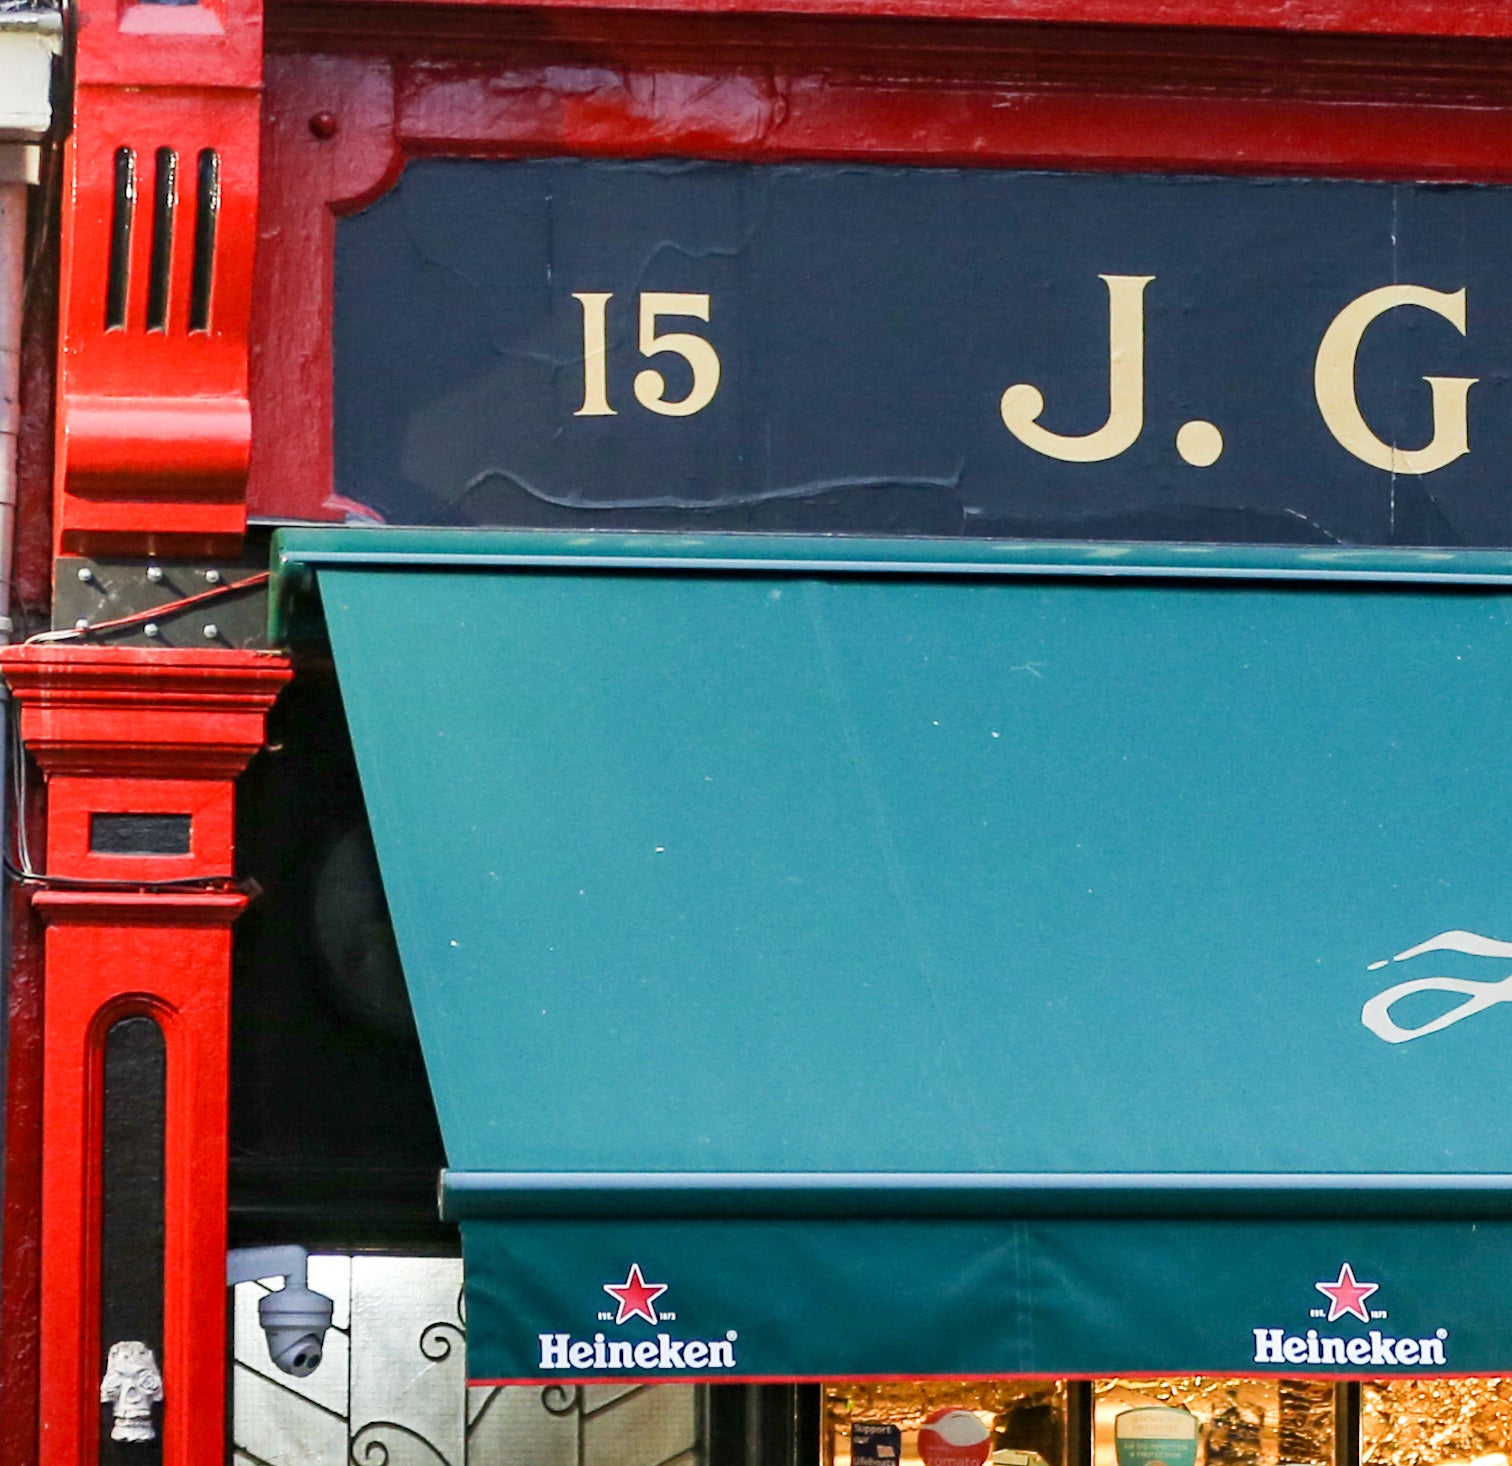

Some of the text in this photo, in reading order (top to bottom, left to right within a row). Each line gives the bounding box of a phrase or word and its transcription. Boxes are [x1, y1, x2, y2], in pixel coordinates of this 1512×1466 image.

[572, 292, 722, 419] 15
[1000, 274, 1224, 468] J.
[853, 1423, 892, 1435] Support
